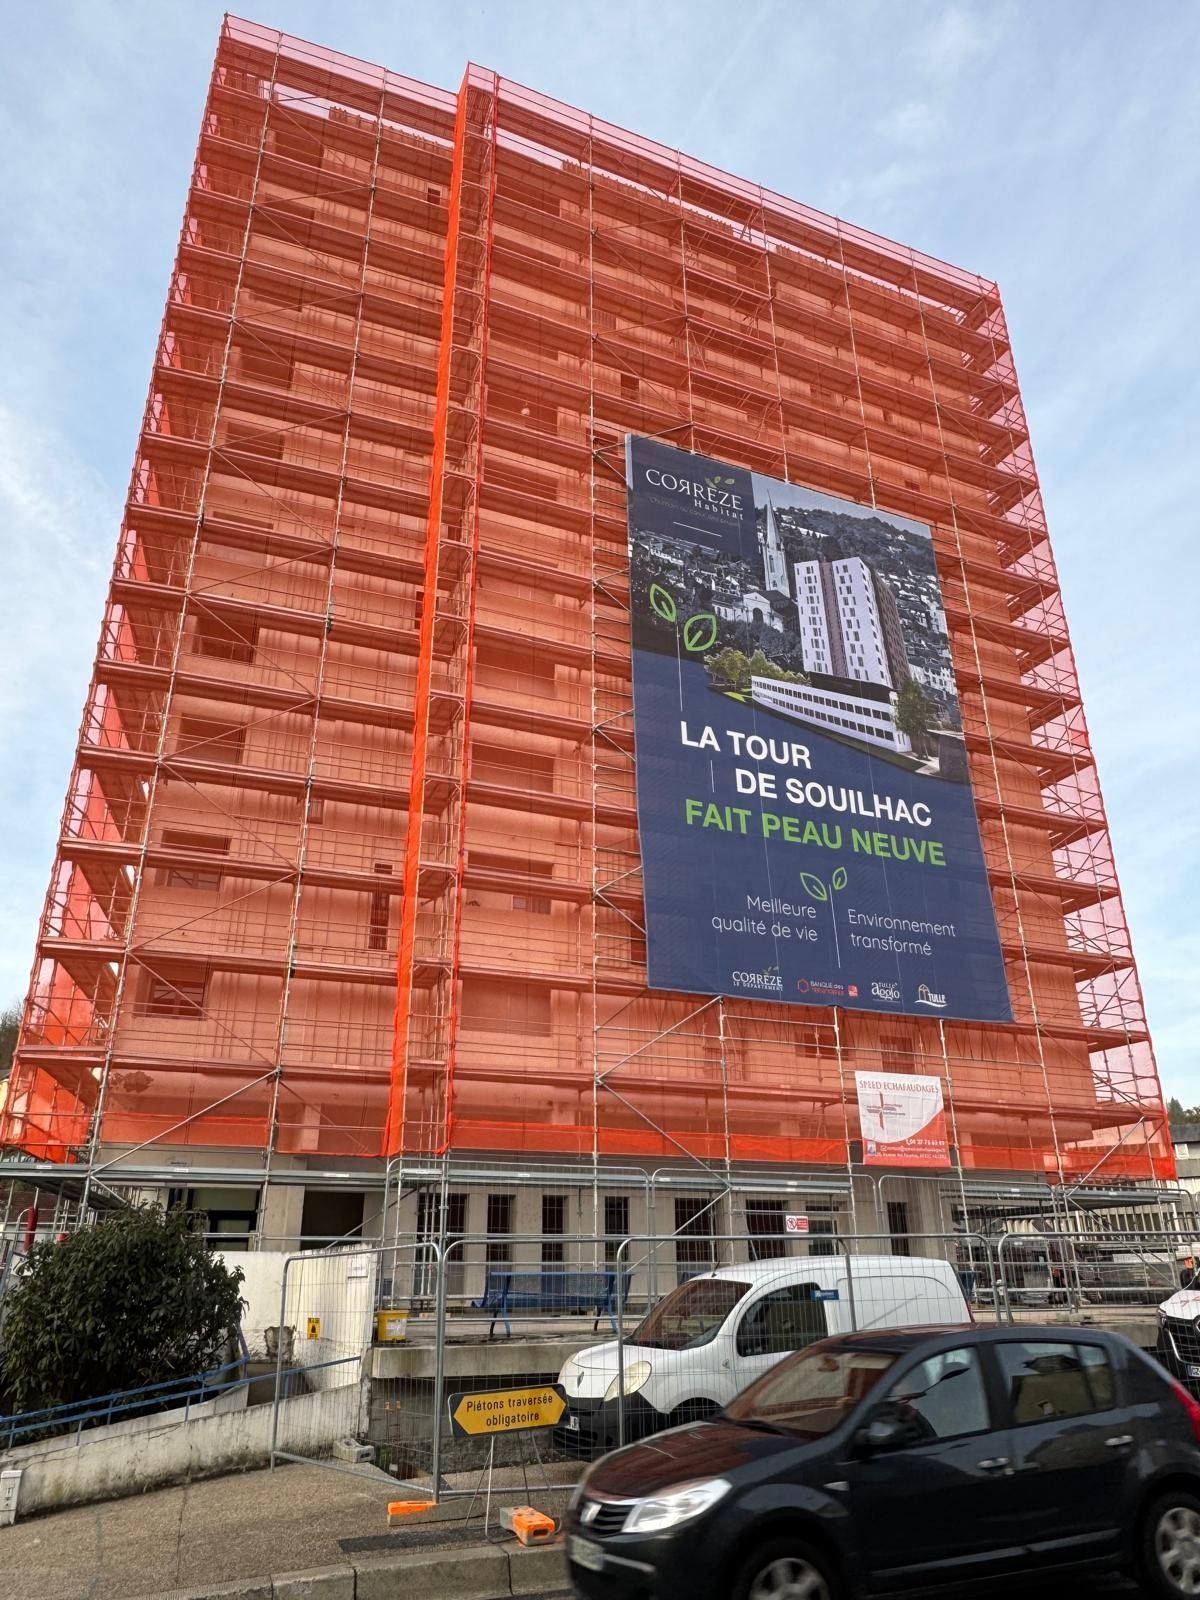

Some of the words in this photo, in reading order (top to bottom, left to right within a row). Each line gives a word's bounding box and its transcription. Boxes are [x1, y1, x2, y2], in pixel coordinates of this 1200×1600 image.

[694, 499, 743, 520] Habitat
[681, 721, 720, 751] LA
[726, 730, 811, 769] TOUR
[735, 768, 777, 799] DE
[785, 778, 932, 827] SOUILHAC
[685, 799, 751, 834] FAIT
[762, 812, 842, 849] PEAU
[852, 828, 946, 866] NEUVE
[747, 895, 817, 919] Meilleure
[711, 914, 766, 936] qualité
[771, 921, 791, 938] de
[796, 925, 818, 941] vie
[848, 909, 956, 937] Environnement
[851, 932, 932, 956] transformé
[871, 982, 900, 1000] agglo
[859, 1080, 882, 1090] SPEED
[466, 1399, 504, 1412] Piétons
[508, 1393, 553, 1407] traversée
[486, 1411, 540, 1426] obligatoire
